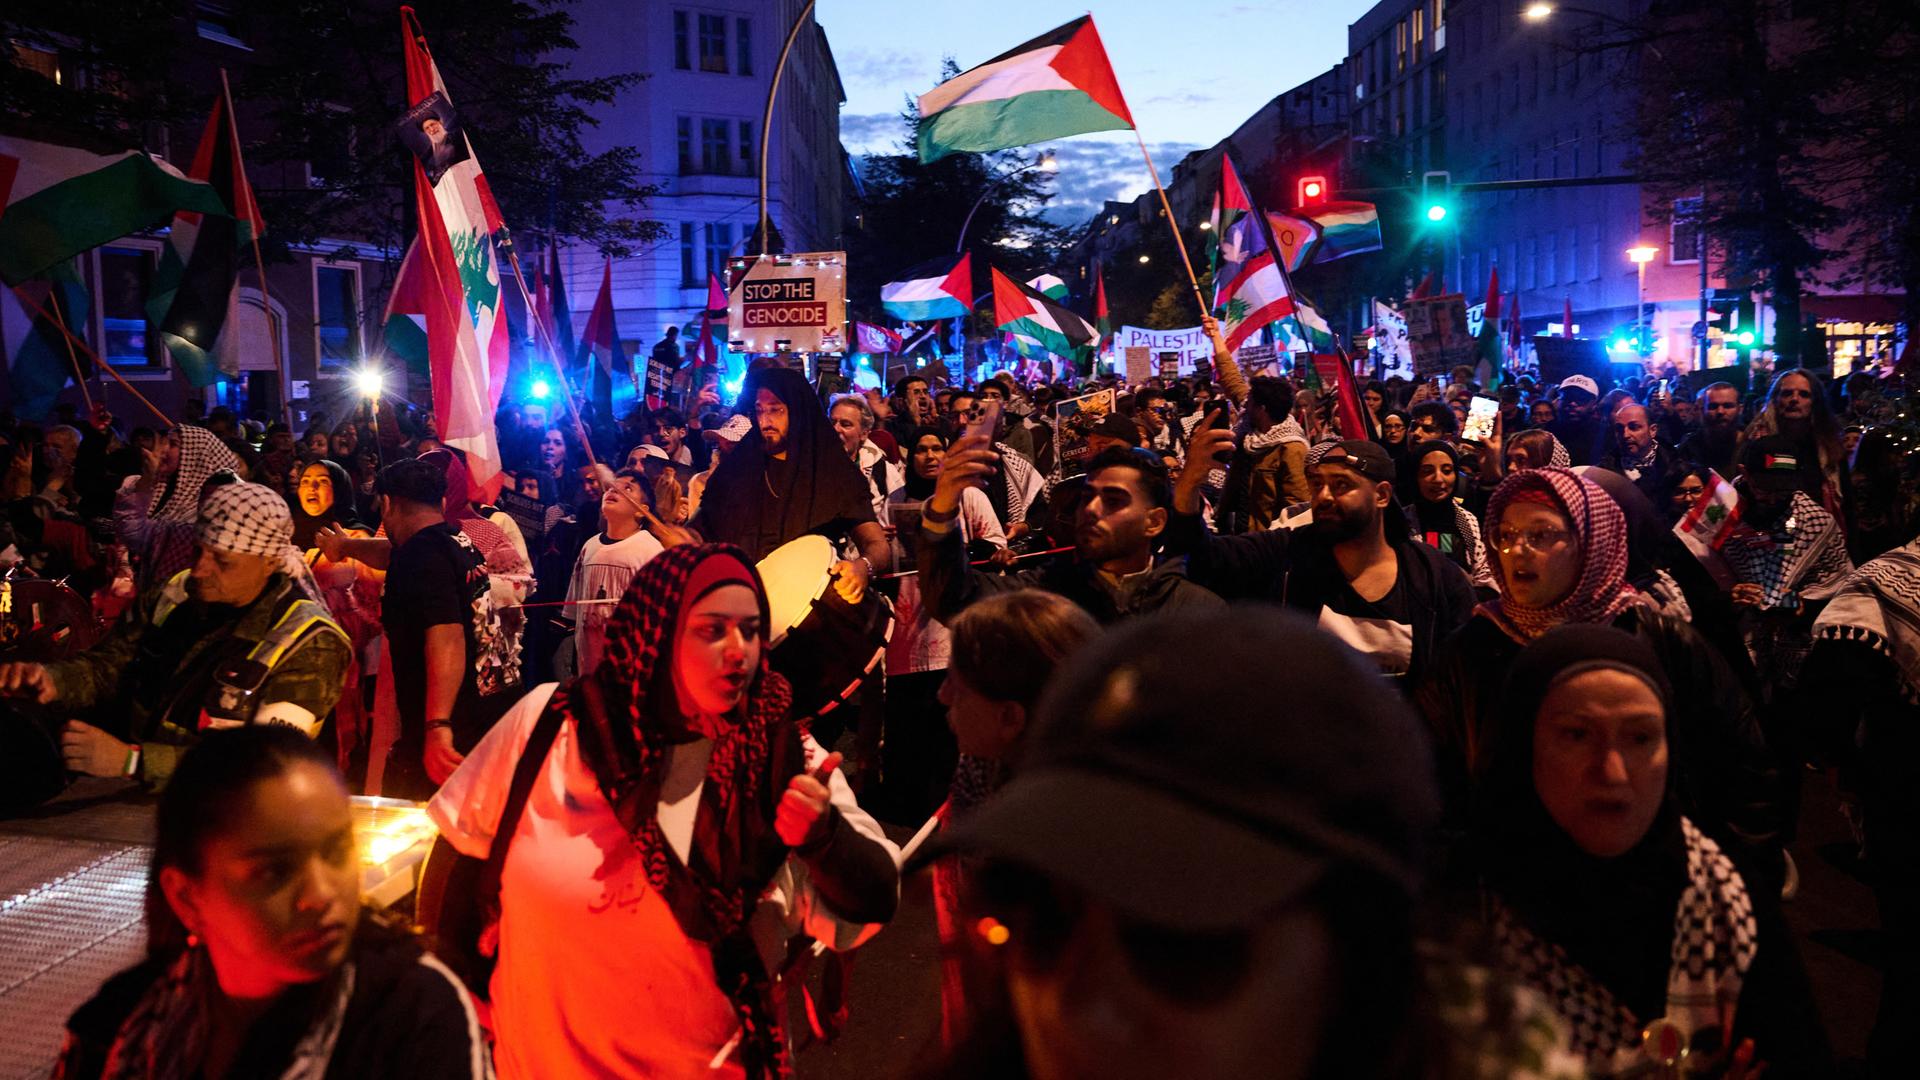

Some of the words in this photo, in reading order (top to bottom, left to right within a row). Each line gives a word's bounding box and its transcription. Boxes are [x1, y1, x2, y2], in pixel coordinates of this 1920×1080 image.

[744, 283, 781, 300] STOP
[784, 281, 812, 298] THE
[745, 306, 825, 324] GENOCIDE
